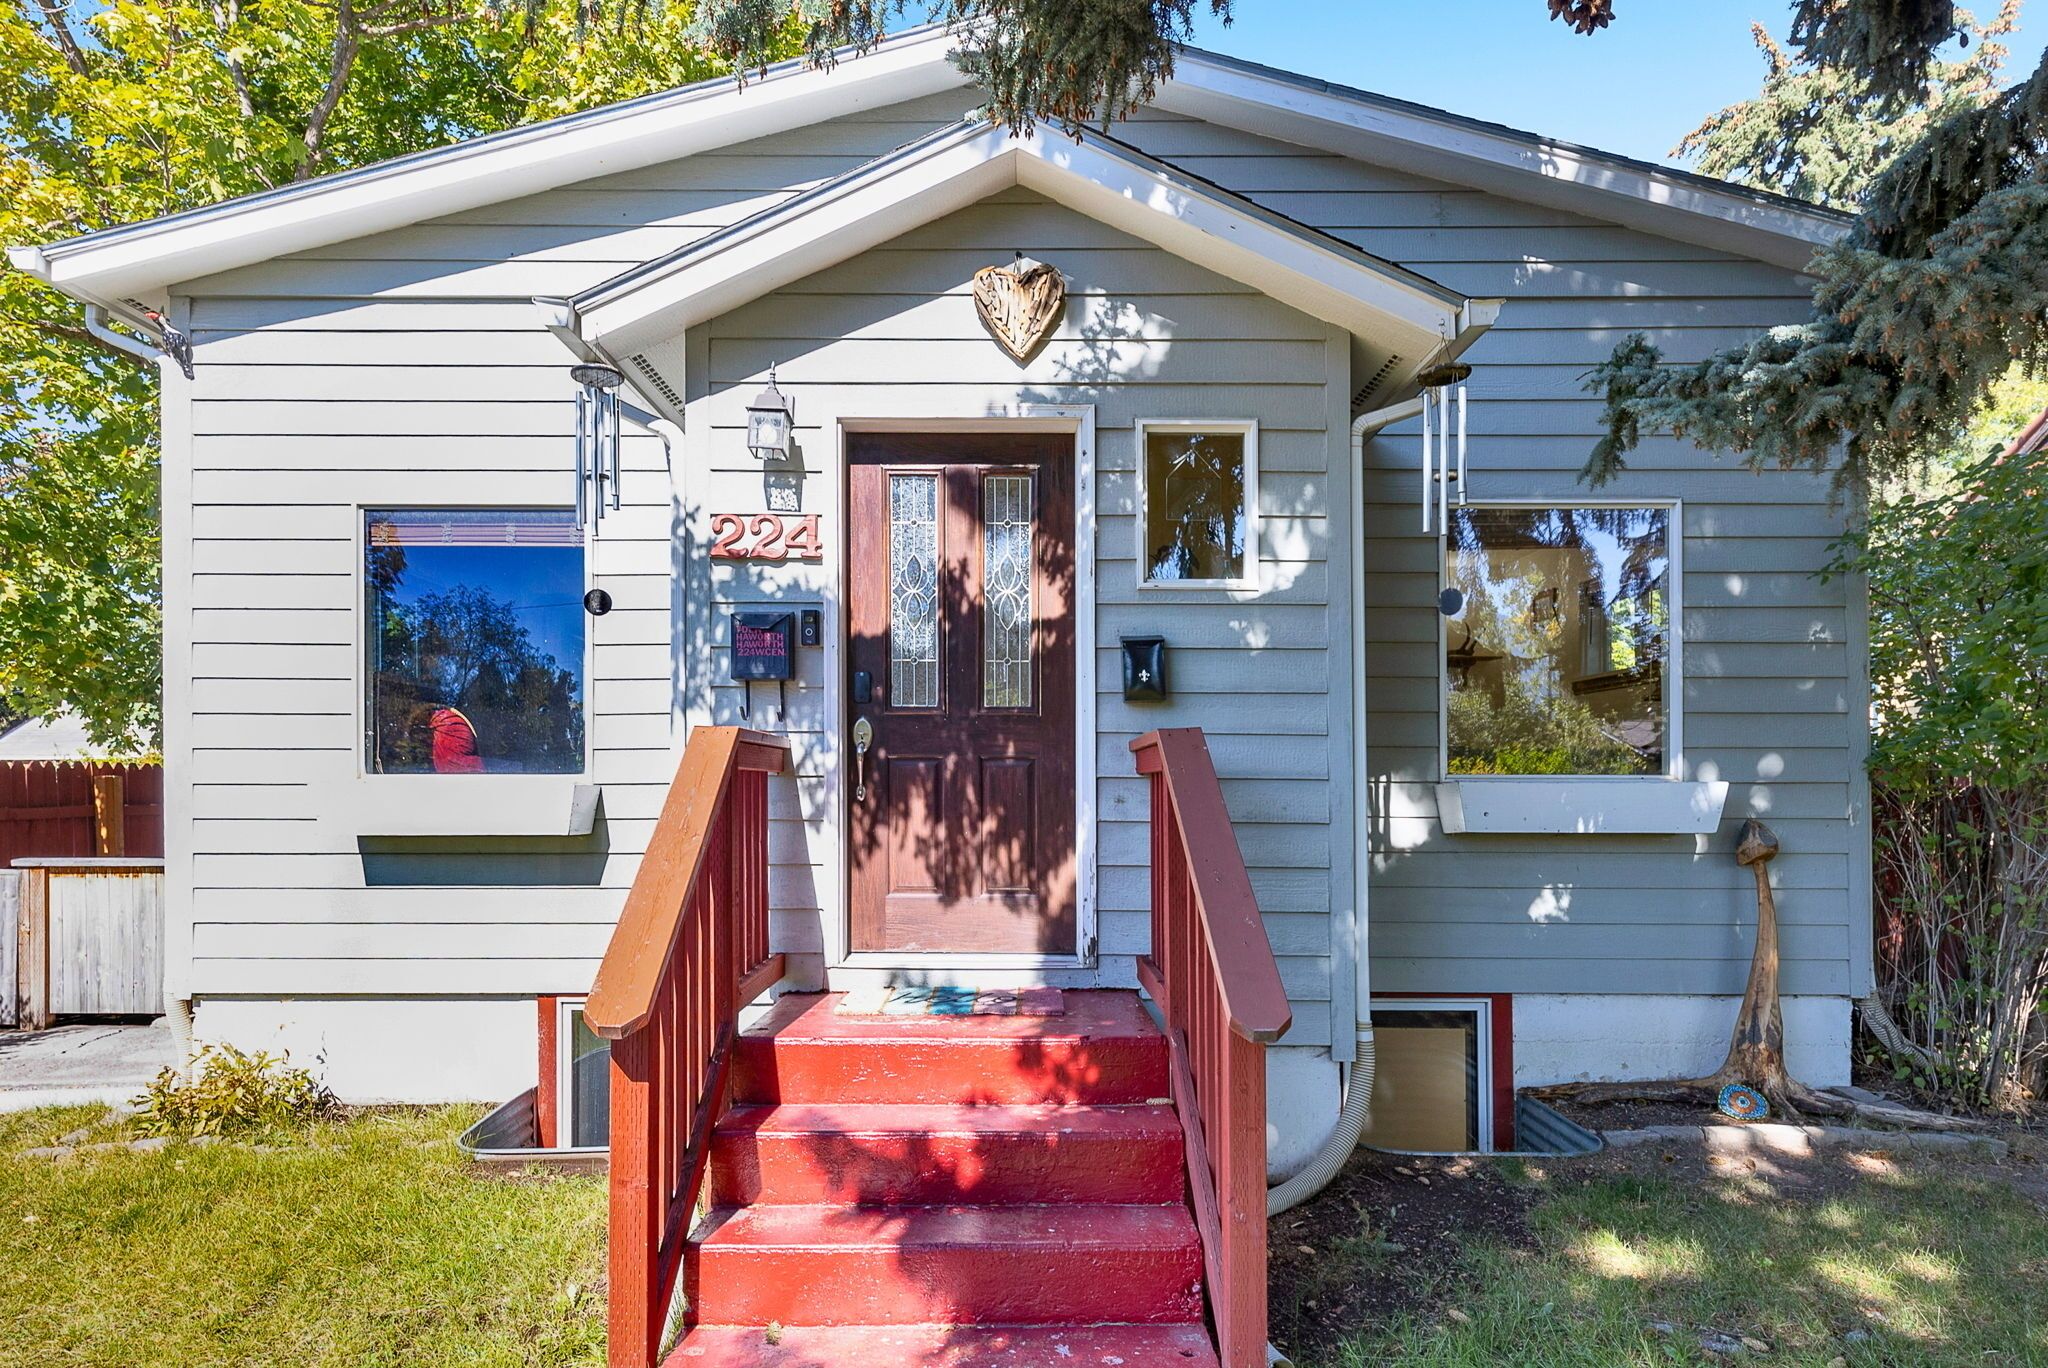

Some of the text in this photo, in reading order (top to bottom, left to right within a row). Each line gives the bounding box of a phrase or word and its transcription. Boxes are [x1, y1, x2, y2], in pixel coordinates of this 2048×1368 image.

[709, 514, 823, 560] 224
[736, 632, 784, 641] HAWORTH
[736, 640, 784, 649] HAWORTH
